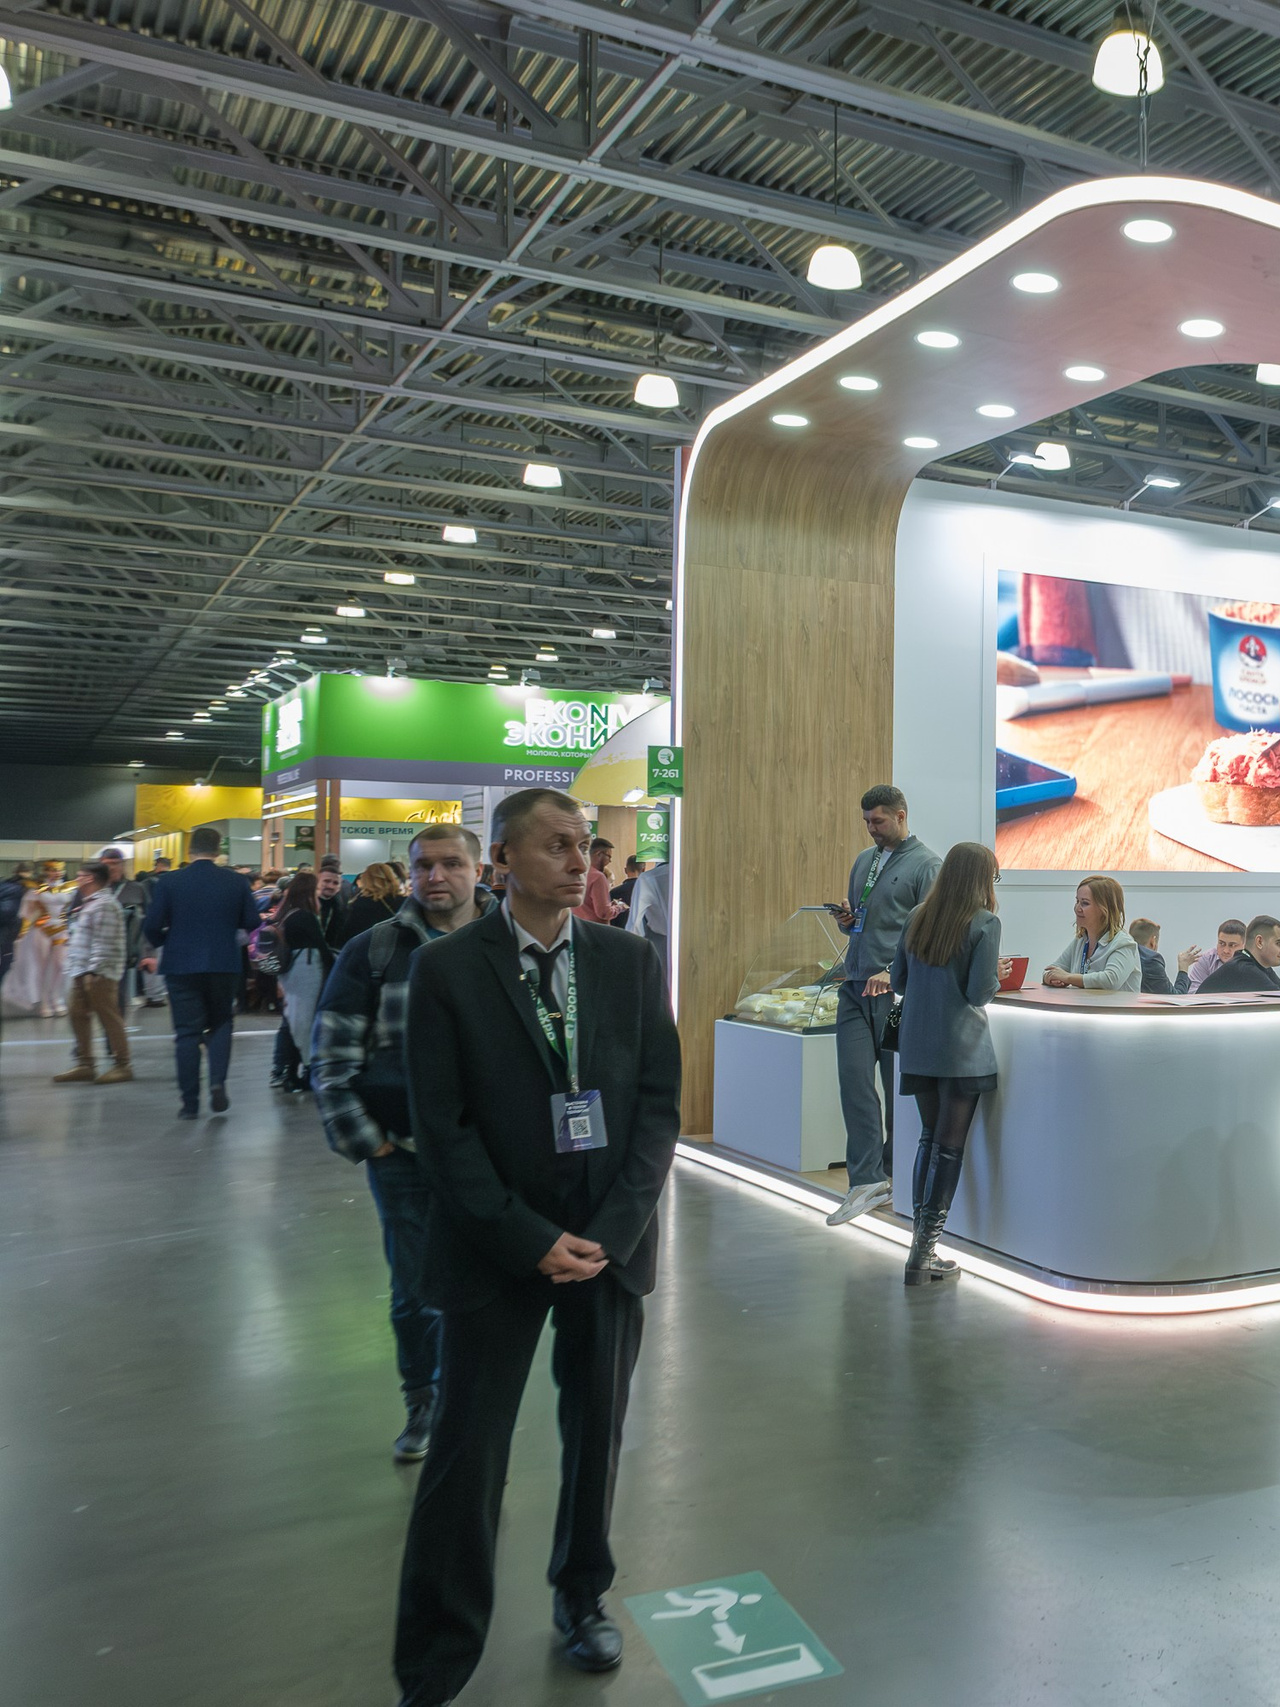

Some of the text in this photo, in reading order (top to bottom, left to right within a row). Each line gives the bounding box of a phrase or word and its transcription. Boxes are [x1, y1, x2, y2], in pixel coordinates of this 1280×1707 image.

[504, 721, 617, 748] ЭКОНИ
[504, 768, 574, 782] PROFESSI
[652, 768, 679, 778] 7-261
[341, 826, 414, 835] ТСКОЕ ВРЕМЯ
[640, 833, 668, 842] 7-260
[566, 986, 577, 1021] FOOD
[537, 1007, 556, 1041] EXPO
